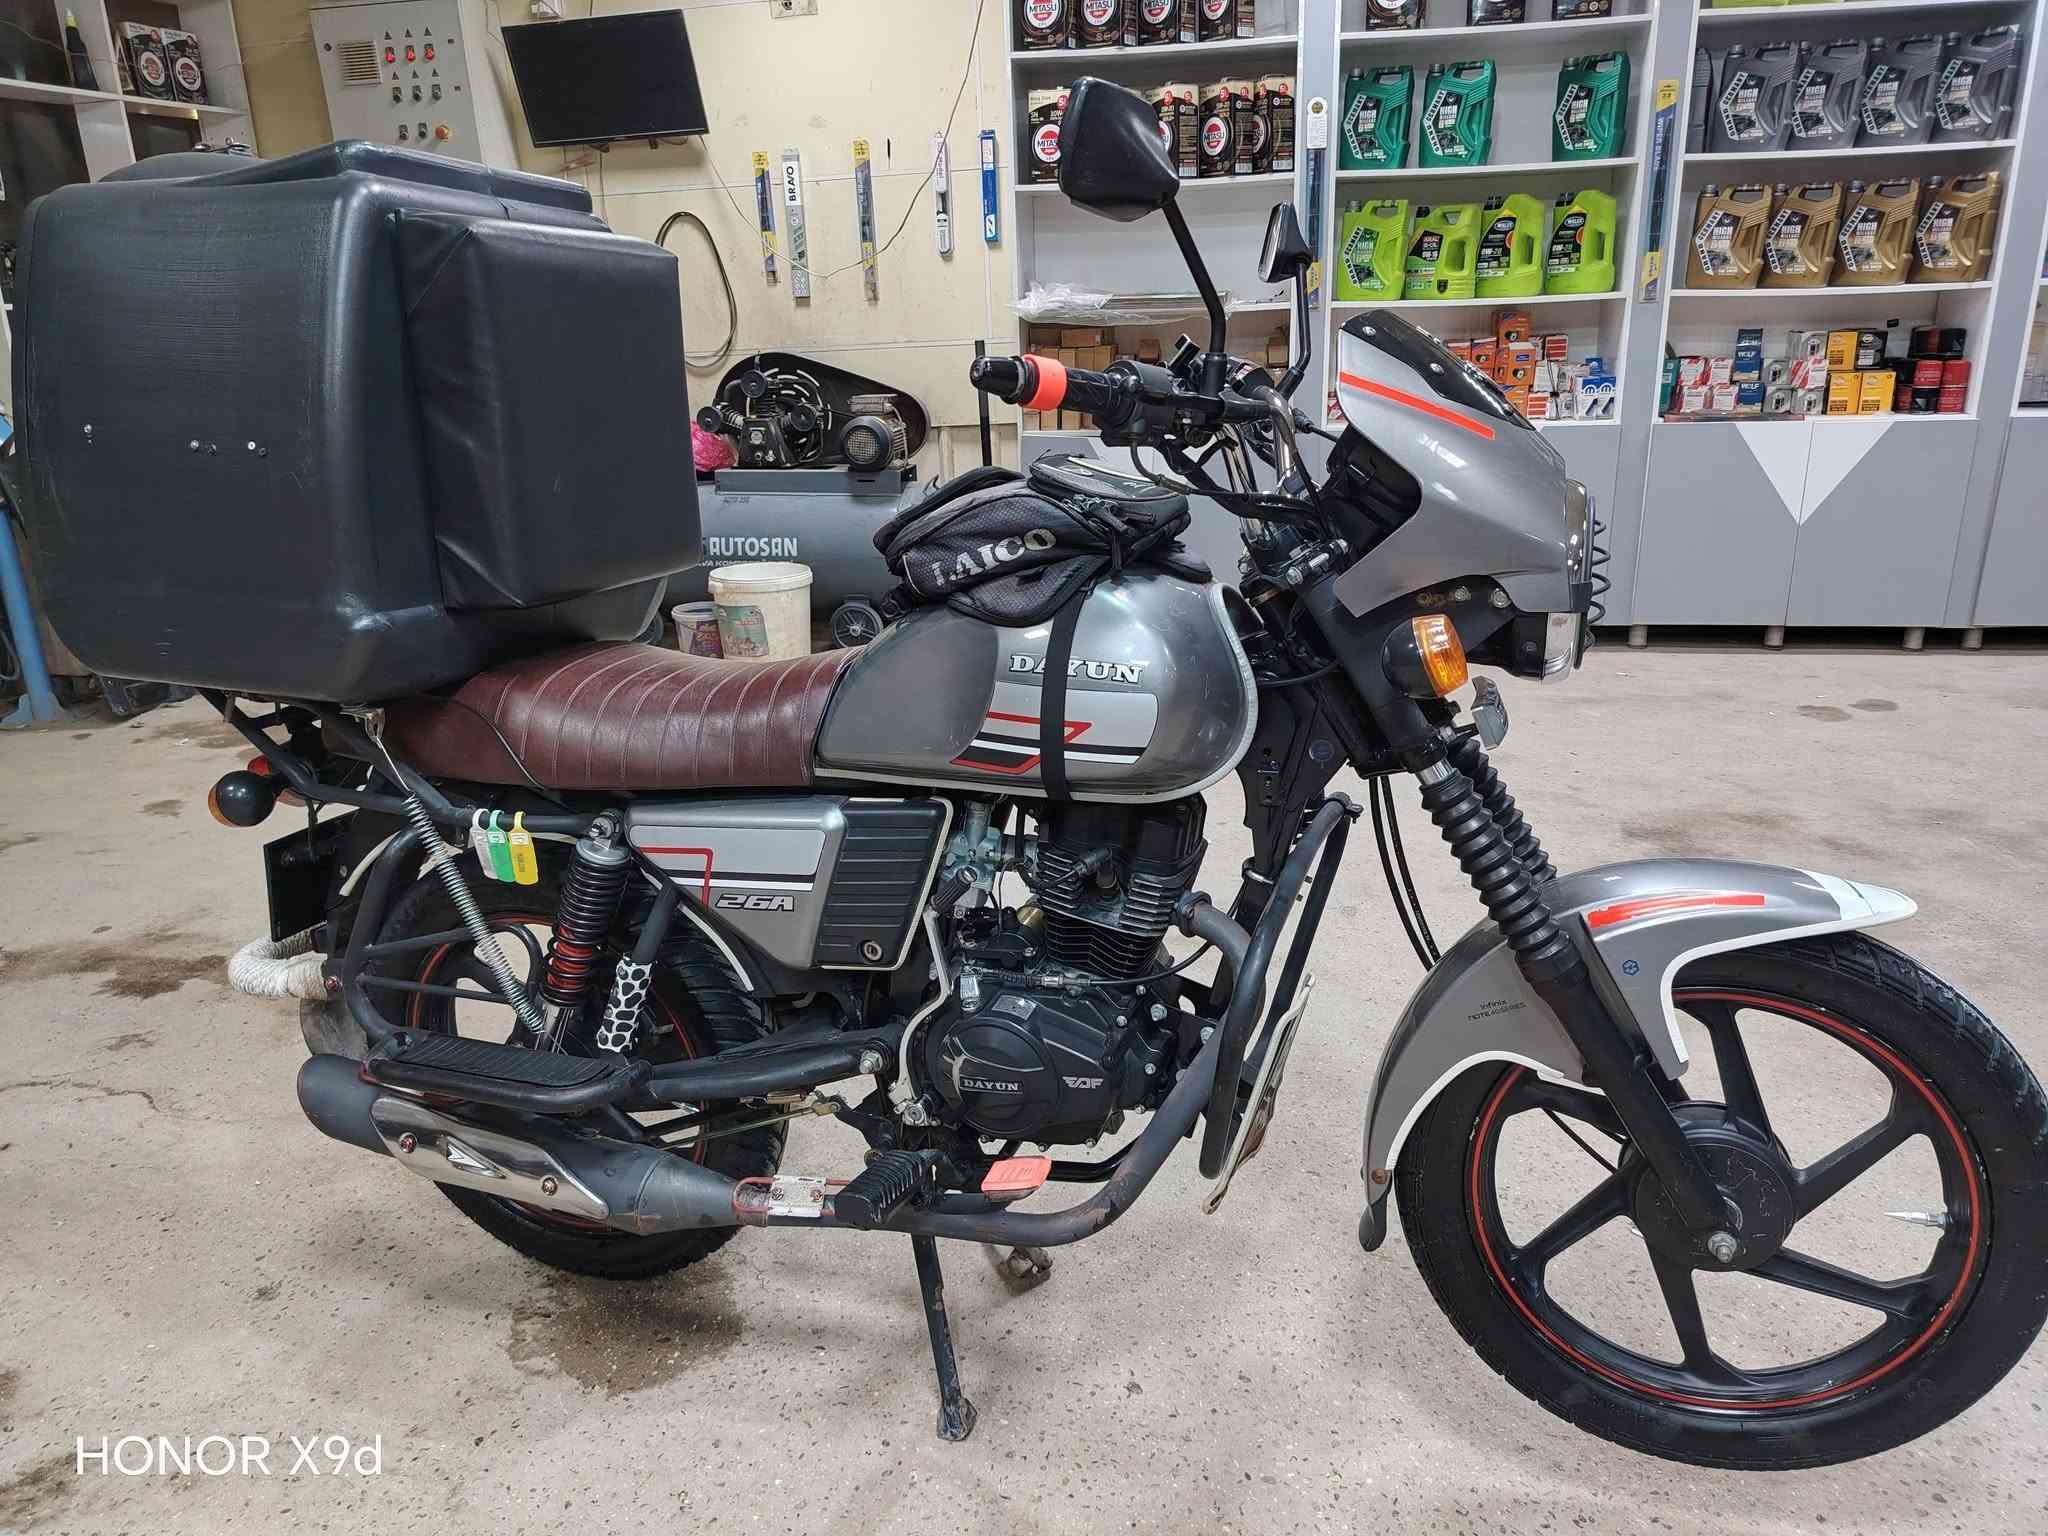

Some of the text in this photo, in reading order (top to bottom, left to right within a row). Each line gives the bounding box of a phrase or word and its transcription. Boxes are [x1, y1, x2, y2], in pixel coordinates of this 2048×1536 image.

[786, 166, 797, 201] BRAVO
[709, 536, 798, 557] AUTOSAN
[963, 1079, 1019, 1092] DAYUN
